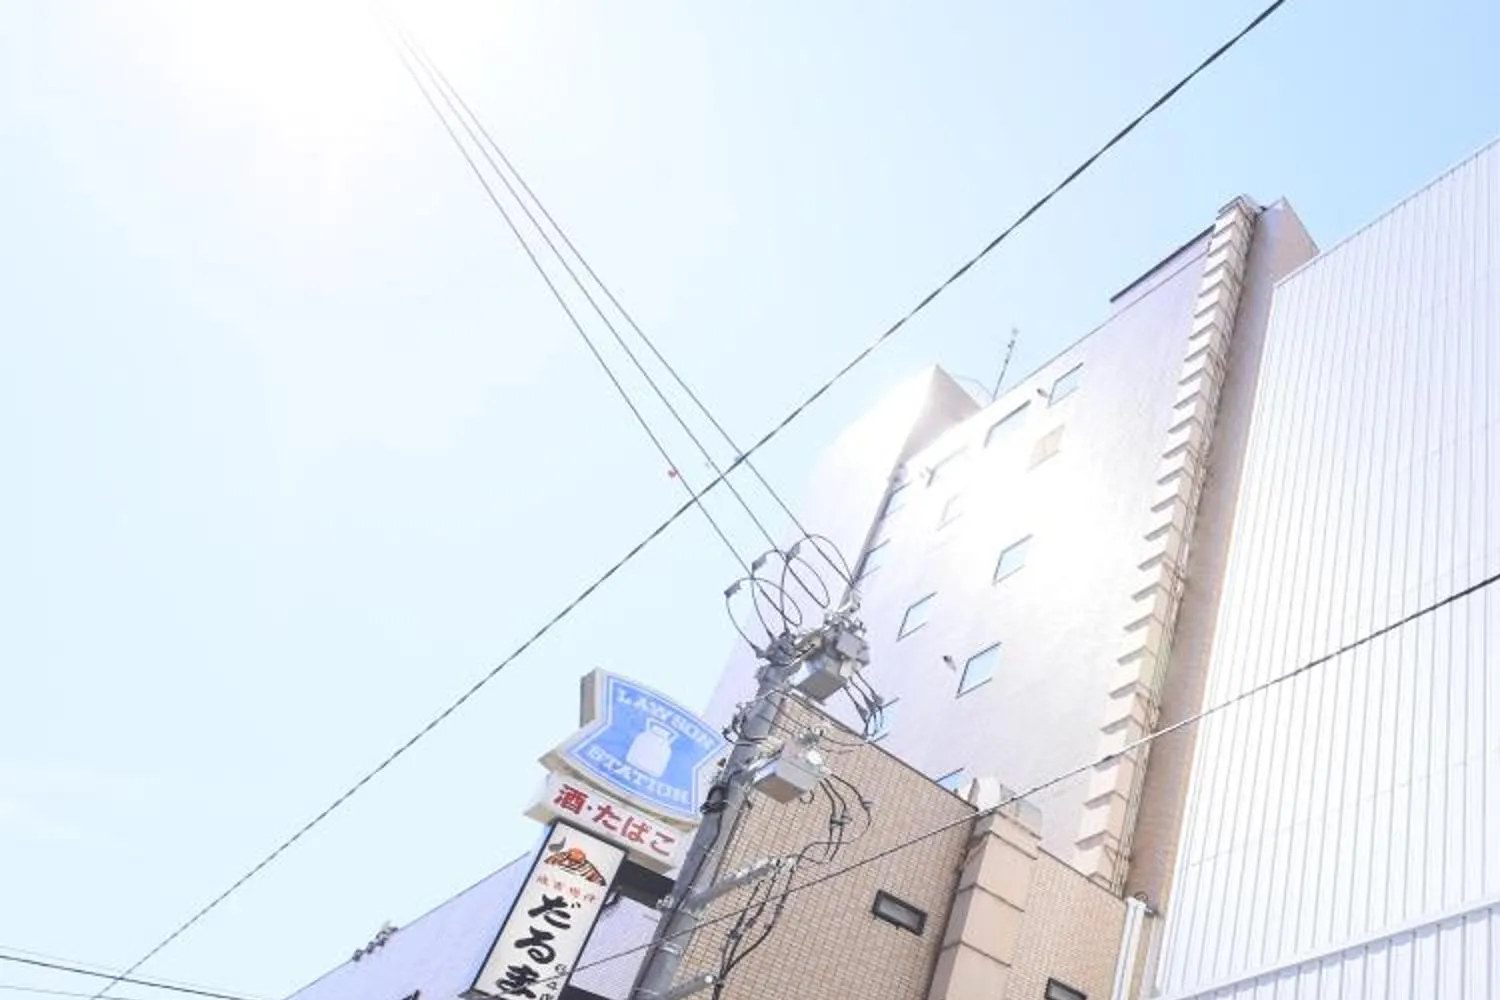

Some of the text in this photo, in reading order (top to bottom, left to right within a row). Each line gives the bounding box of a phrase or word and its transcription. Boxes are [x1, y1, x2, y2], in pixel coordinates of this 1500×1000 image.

[615, 687, 717, 751] LAWSON
[585, 744, 690, 801] STATION
[496, 893, 582, 1000] だるま
